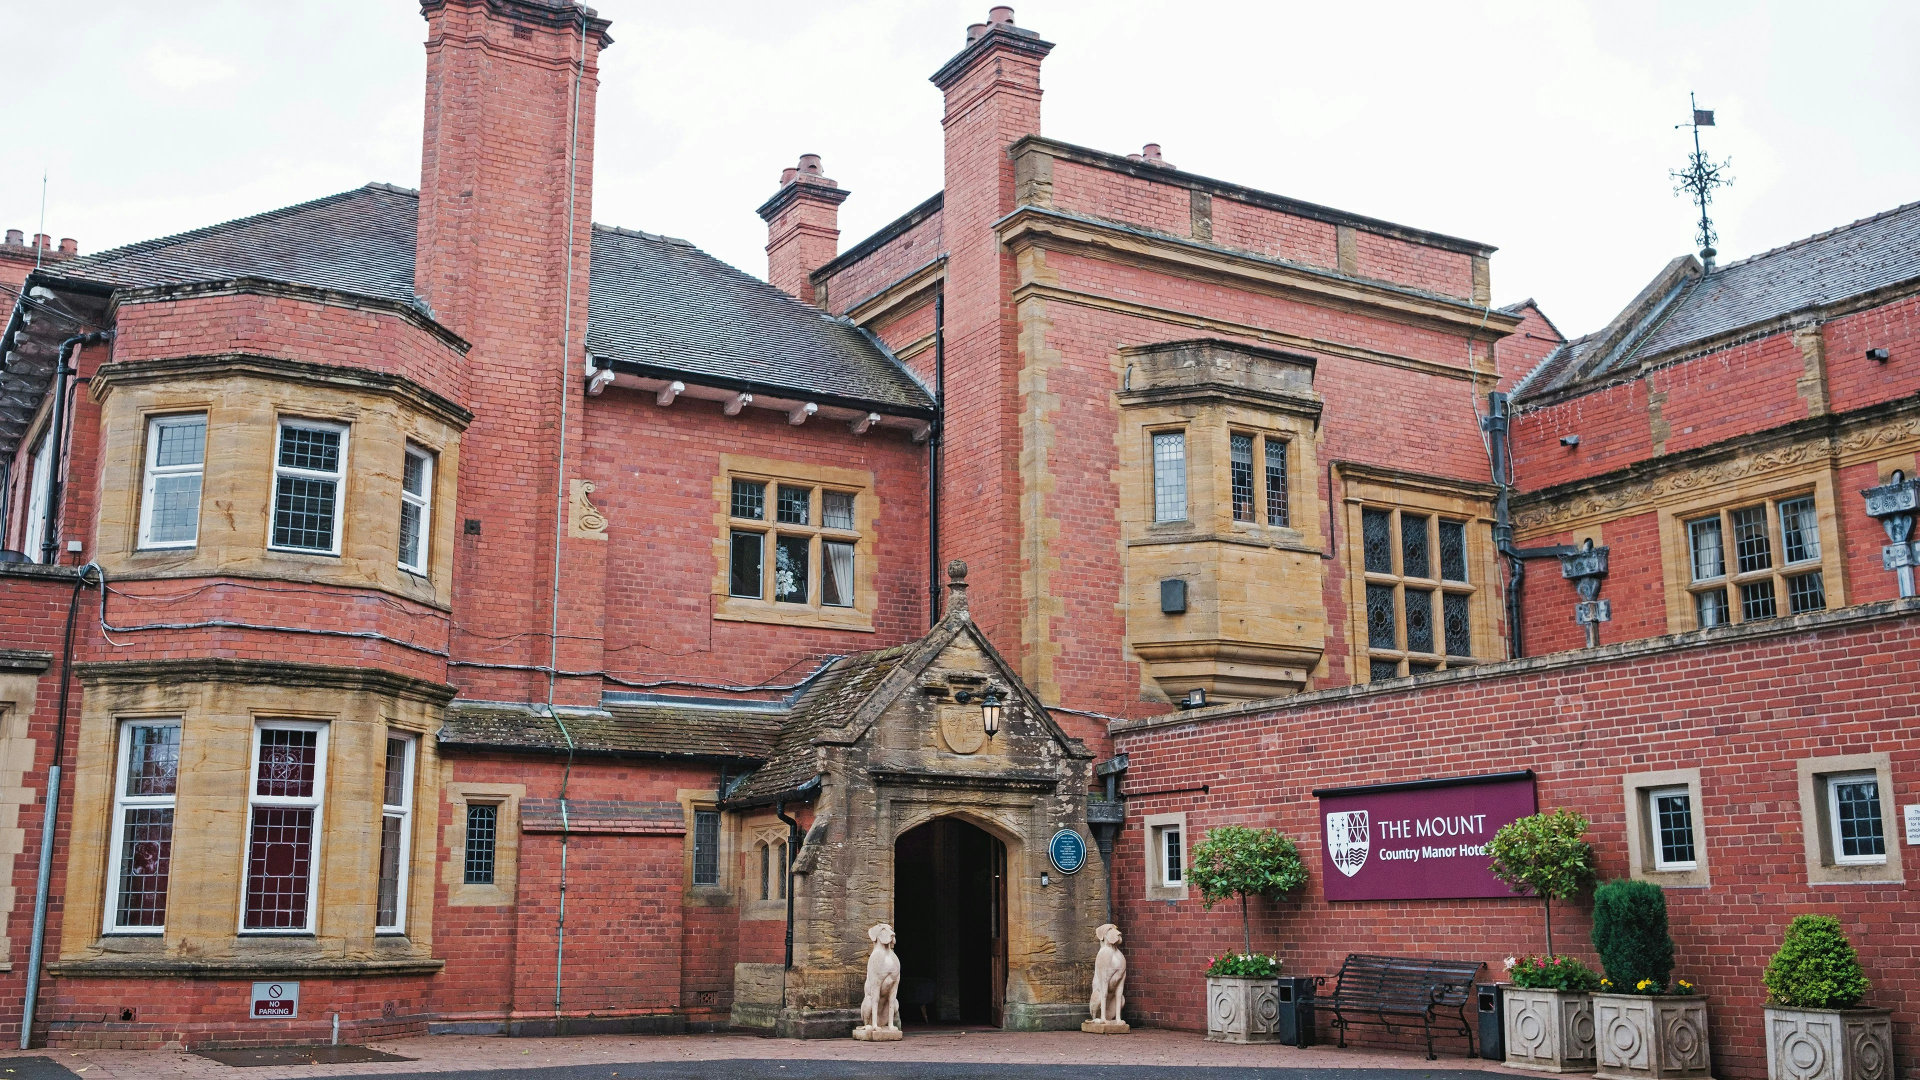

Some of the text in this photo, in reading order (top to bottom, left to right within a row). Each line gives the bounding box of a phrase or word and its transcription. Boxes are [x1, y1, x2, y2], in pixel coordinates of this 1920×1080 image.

[1378, 814, 1486, 839] THE MOUNT
[1379, 848, 1419, 862] Country
[1422, 846, 1457, 859] Manor
